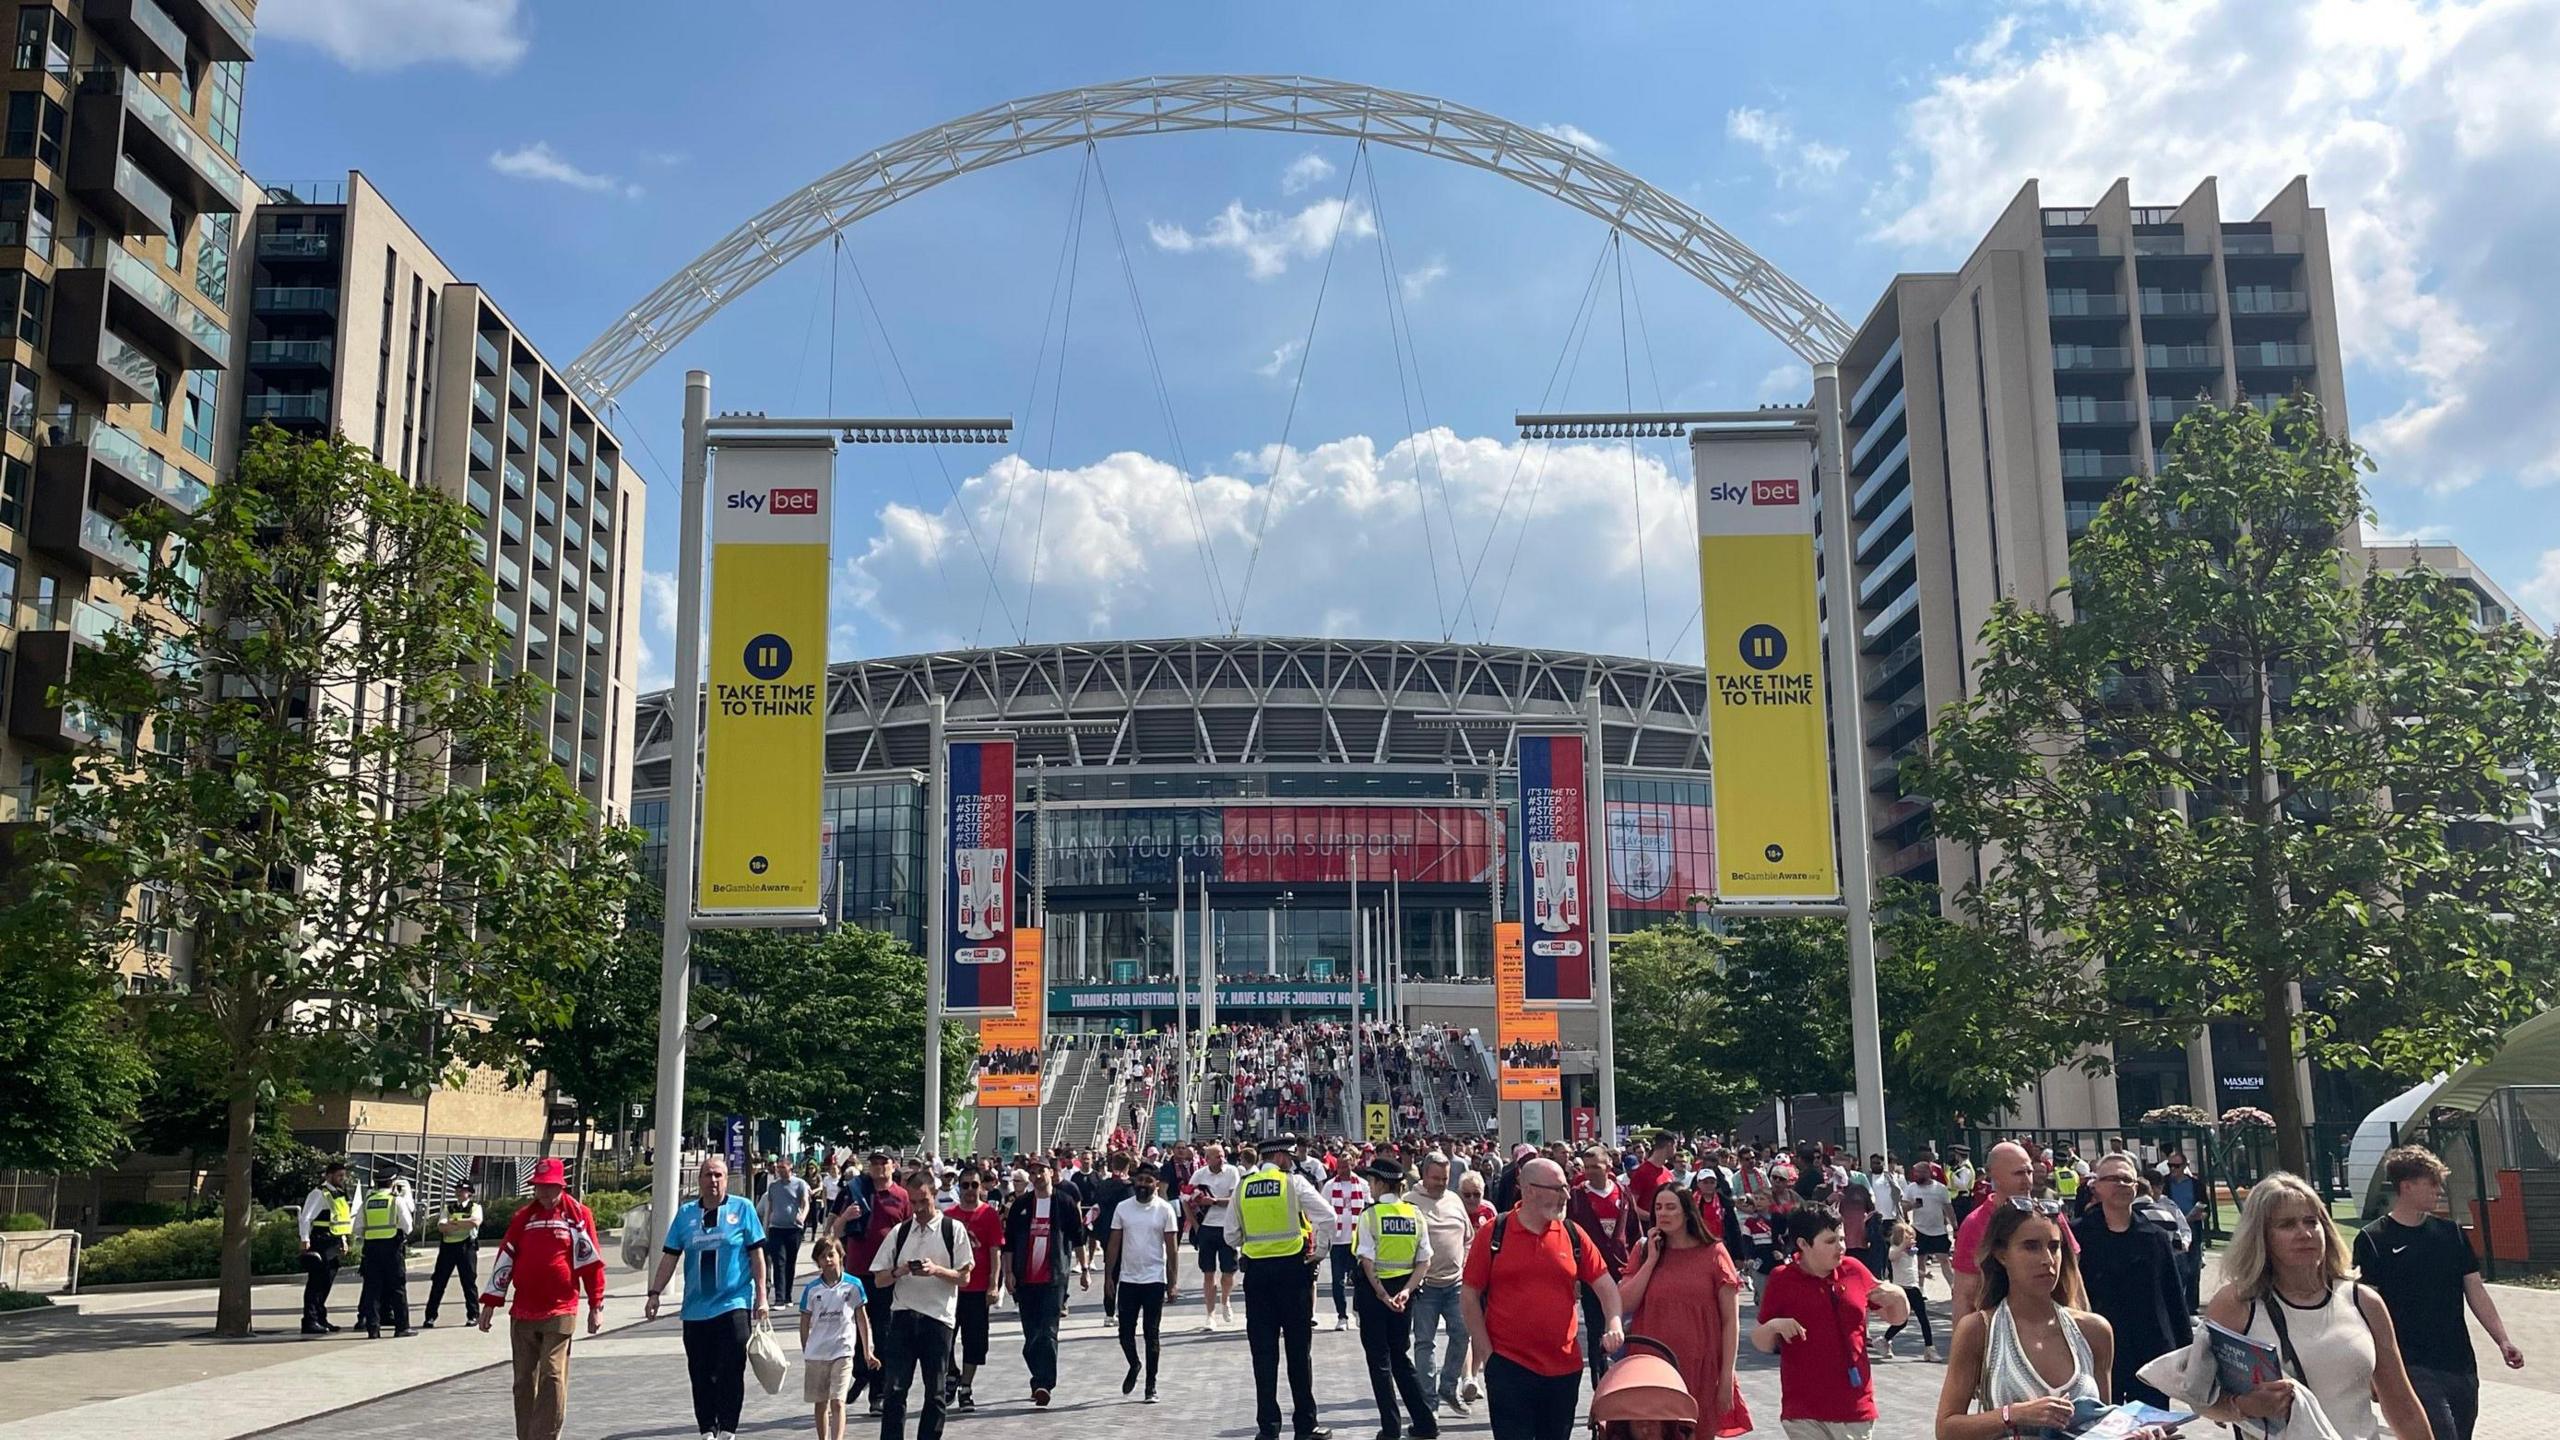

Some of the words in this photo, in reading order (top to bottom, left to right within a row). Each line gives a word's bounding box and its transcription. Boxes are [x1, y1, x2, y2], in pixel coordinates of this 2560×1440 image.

[727, 490, 766, 513] sky
[775, 491, 814, 509] bet
[1710, 482, 1748, 505] sky
[1756, 482, 1795, 500] bet
[1715, 674, 1764, 690] TAKE
[1767, 674, 1814, 689] TIME
[716, 684, 765, 700] TAKE
[769, 684, 816, 700] TIME
[1721, 691, 1748, 706] TO
[1751, 690, 1812, 705] THINK
[721, 701, 747, 716] TO
[752, 701, 813, 716] THINK
[972, 794, 993, 803] TIME
[994, 794, 1007, 803] TO
[1544, 787, 1563, 796] TIME
[1564, 787, 1577, 796] TO
[1123, 834, 1171, 858] YOU
[1180, 834, 1224, 858] FOR
[1232, 833, 1296, 857] YOUR
[1304, 833, 1413, 857] SUPPORT
[1767, 849, 1782, 859] 18+
[751, 861, 767, 870] 18+
[1071, 993, 1110, 1007] THANKS
[1112, 993, 1130, 1006] FOR
[1132, 992, 1175, 1006] VISITING
[1231, 991, 1257, 1005] HAVE
[1258, 991, 1266, 1005] A
[1267, 991, 1291, 1005] SAFE
[1292, 991, 1336, 1005] JOURNEY
[1338, 992, 1366, 1005] HOE
[1246, 1180, 1280, 1196] POLICE
[1383, 1218, 1416, 1234] POLICE
